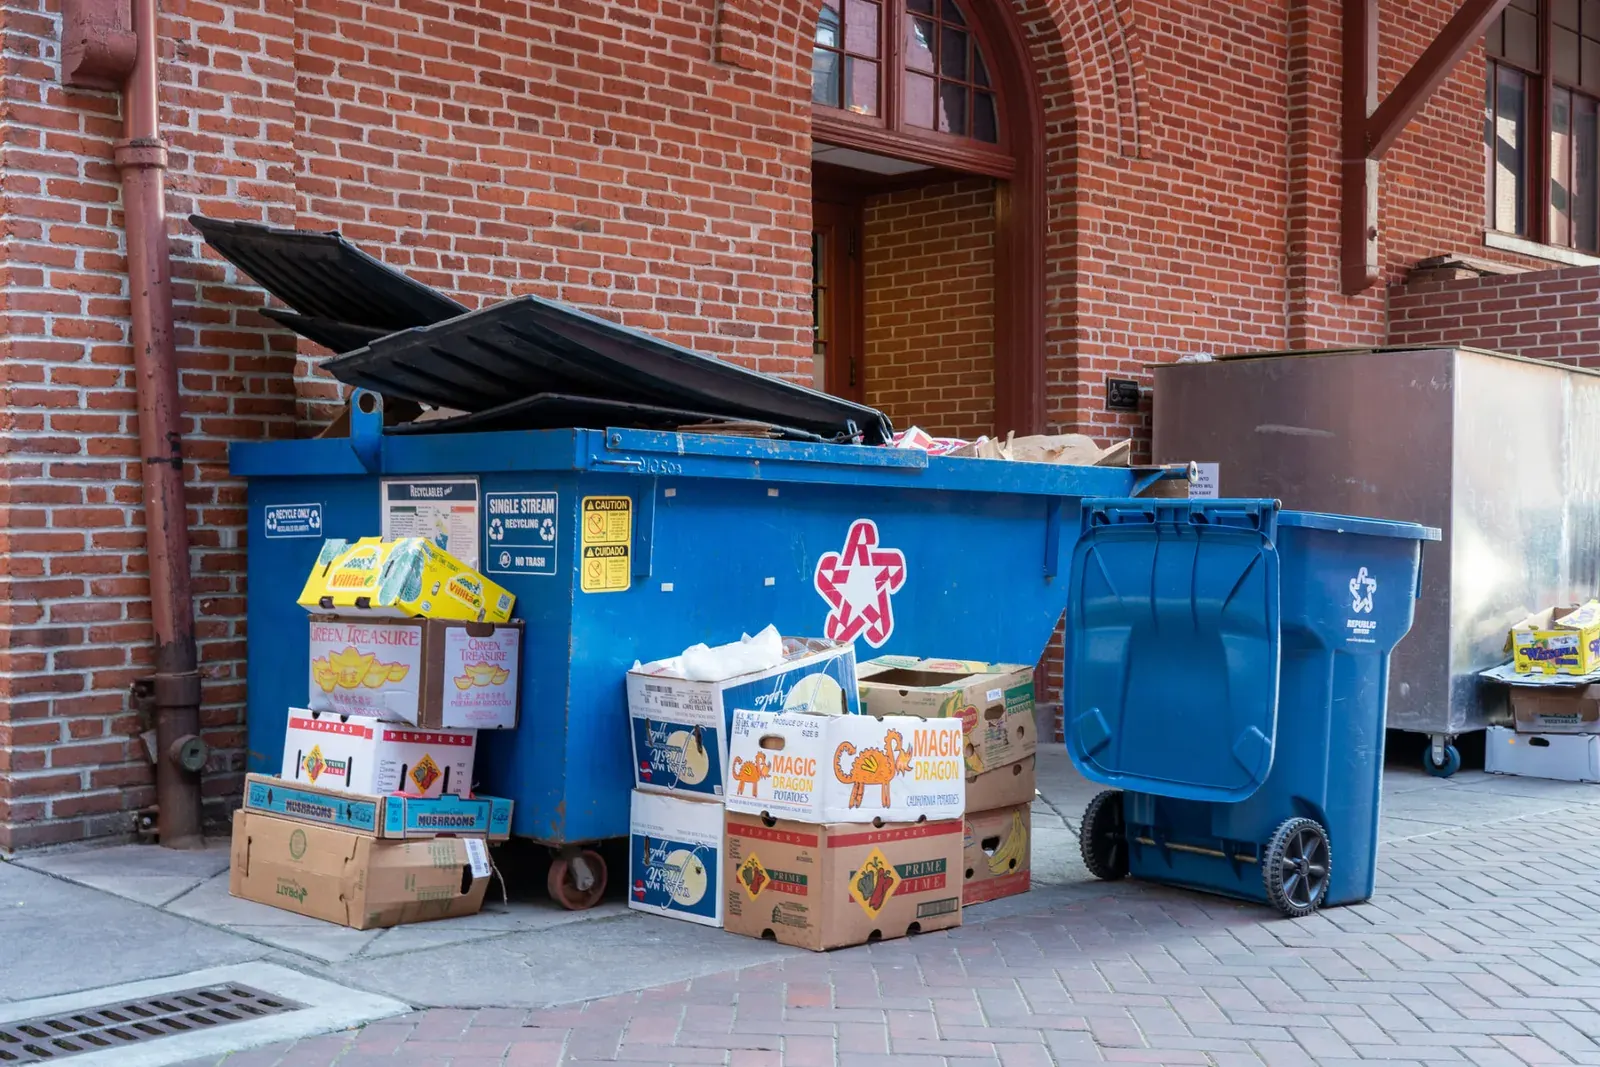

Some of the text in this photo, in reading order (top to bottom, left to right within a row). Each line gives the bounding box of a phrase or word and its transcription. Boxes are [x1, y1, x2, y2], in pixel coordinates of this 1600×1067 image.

[410, 484, 443, 498] RECYCLABLES
[489, 498, 555, 514] SINGLE STREAM
[595, 500, 627, 510] CAUTION
[275, 508, 310, 519] RECYCLE ONLY
[504, 518, 539, 529] RECYCLING
[594, 546, 625, 557] CUIDADO
[515, 556, 546, 567] NO TRASH
[1346, 619, 1377, 630] REPUBLIC
[346, 624, 420, 647] TREASURE
[468, 638, 501, 651] GREEN
[459, 649, 508, 661] TREASURE
[302, 722, 354, 734] PEPPERS
[773, 718, 796, 726] PRODUCE
[796, 719, 804, 727] OF
[390, 731, 467, 745] PEPPERS
[802, 730, 814, 738] SIZE
[913, 729, 961, 757] MAGIC
[772, 755, 817, 777] MAGIC
[915, 761, 959, 781] DRAGON
[772, 775, 813, 793] DRAGON
[773, 790, 810, 804] POTATOES
[906, 795, 936, 807] CALIFORNIA
[286, 800, 333, 819] MUSHROOMS
[418, 814, 476, 828] MUSHROOMS
[740, 827, 801, 843] PEPPERS
[868, 828, 927, 841] PEPPERS
[904, 860, 942, 877] PRIME
[773, 871, 802, 883] PRIME
[773, 882, 801, 893] TIME
[903, 876, 941, 893] TIME
